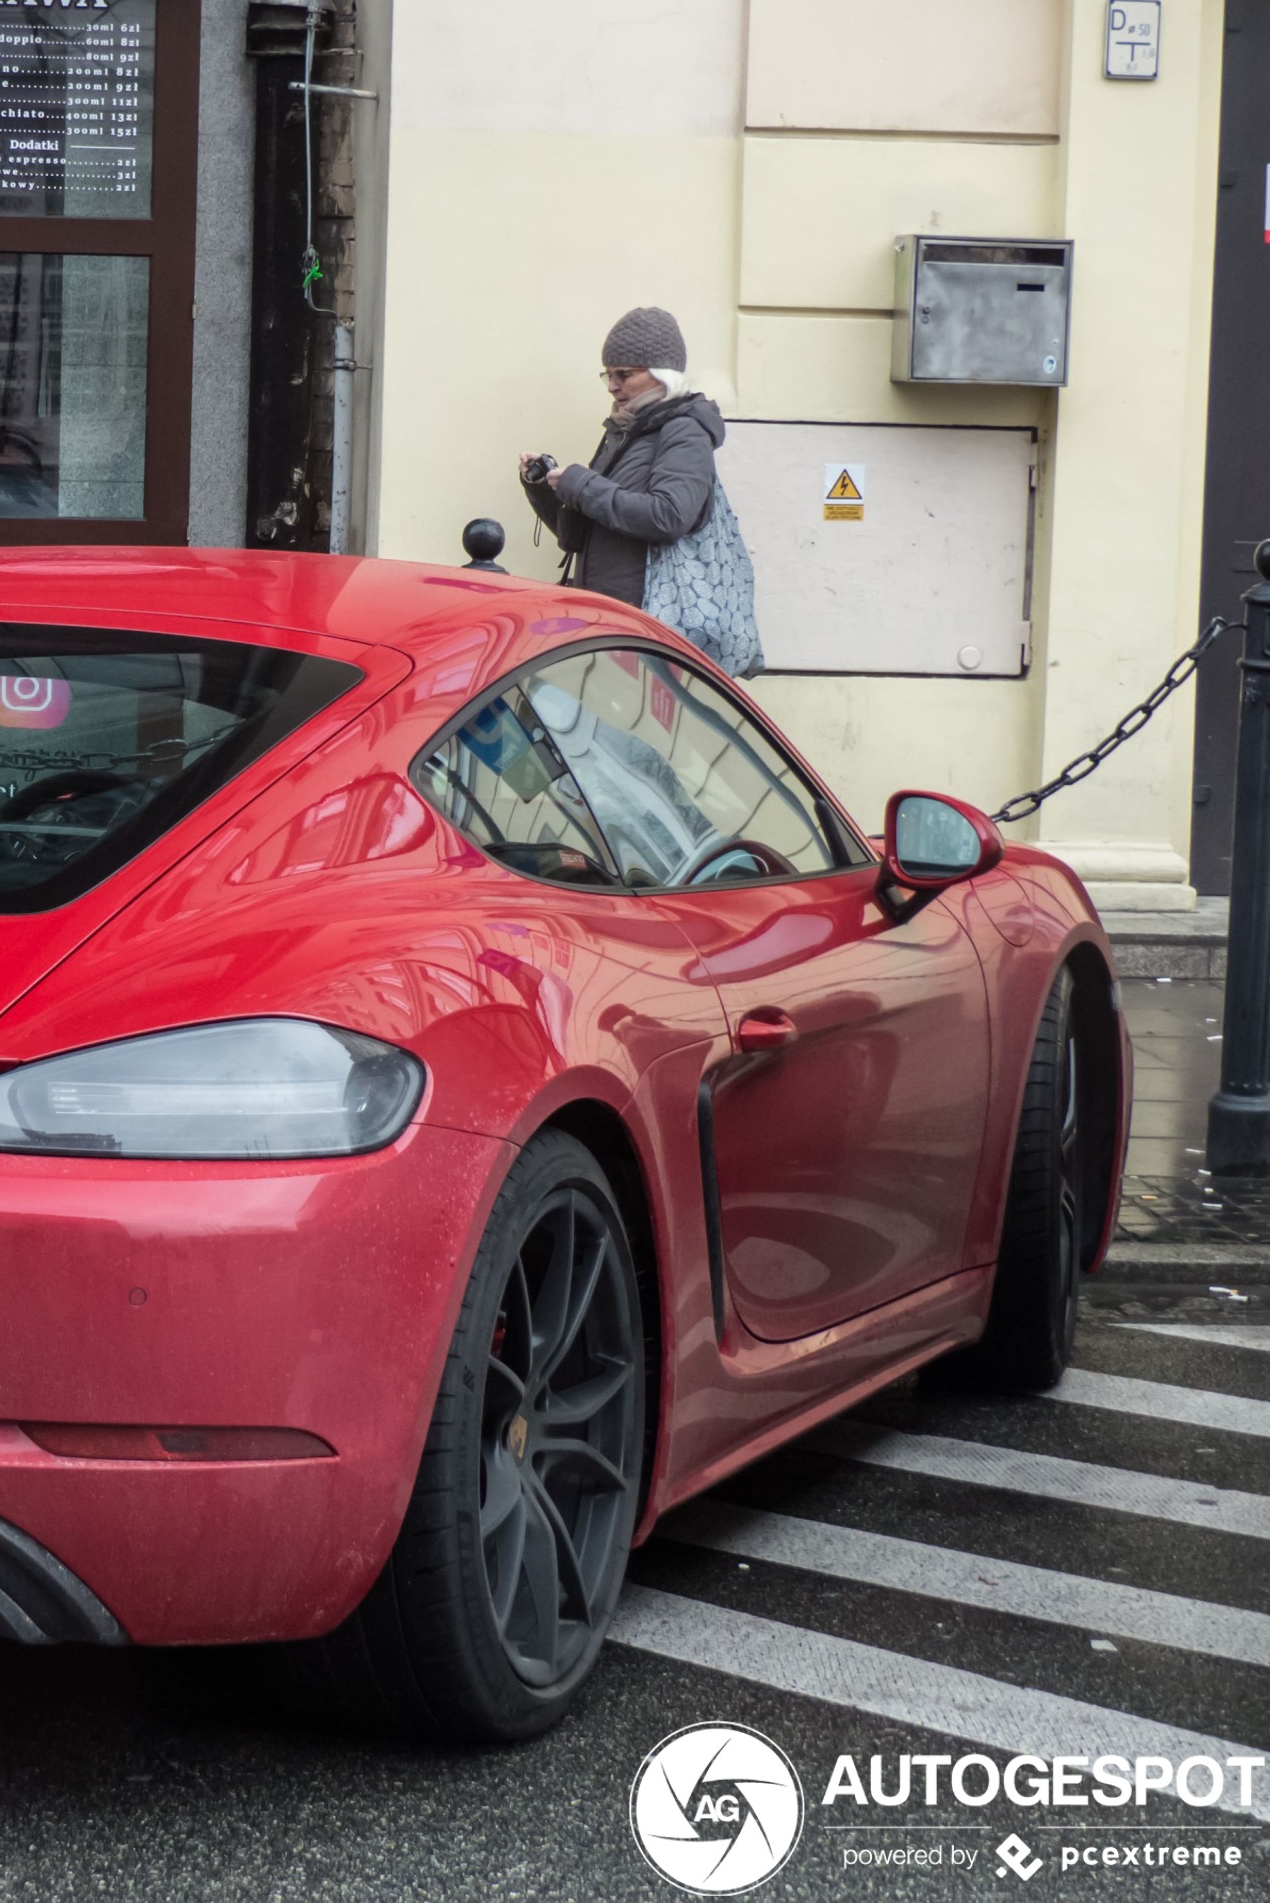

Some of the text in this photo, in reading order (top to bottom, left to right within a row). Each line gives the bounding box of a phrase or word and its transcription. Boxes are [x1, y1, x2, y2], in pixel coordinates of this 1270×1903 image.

[86, 38, 114, 46] 60ml
[120, 53, 139, 62] 9zł
[68, 83, 108, 91] 200ml
[116, 83, 138, 93] 9zł
[67, 98, 105, 106] 300ml
[113, 98, 138, 106] 11zł
[111, 113, 138, 122] 13zł
[66, 127, 103, 135] 300ml
[111, 128, 137, 137] 15zł
[10, 140, 59, 151] Dodatki
[9, 156, 67, 165] espresso
